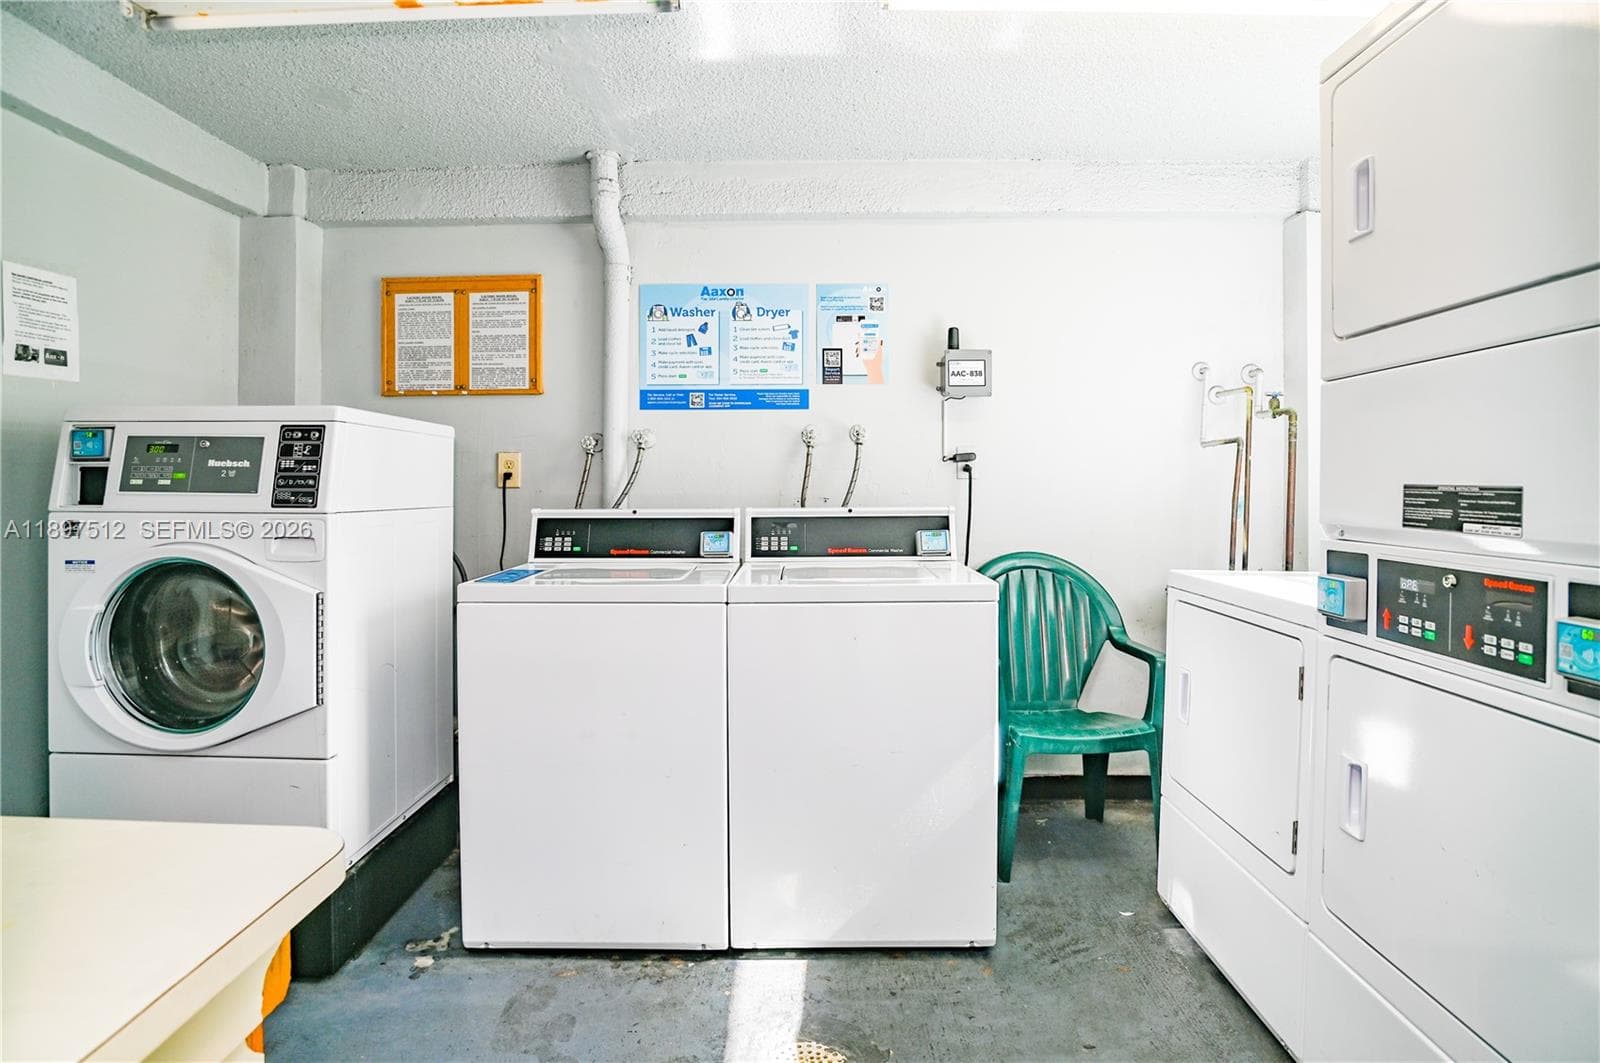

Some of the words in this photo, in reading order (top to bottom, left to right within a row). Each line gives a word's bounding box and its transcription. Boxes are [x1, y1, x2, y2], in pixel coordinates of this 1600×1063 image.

[700, 286, 744, 297] Aaxon
[670, 306, 716, 318] Washer
[757, 306, 791, 320] Dryer
[208, 459, 250, 468] Huebsch
[1484, 578, 1508, 588] Speed
[1508, 581, 1536, 592] Queen
